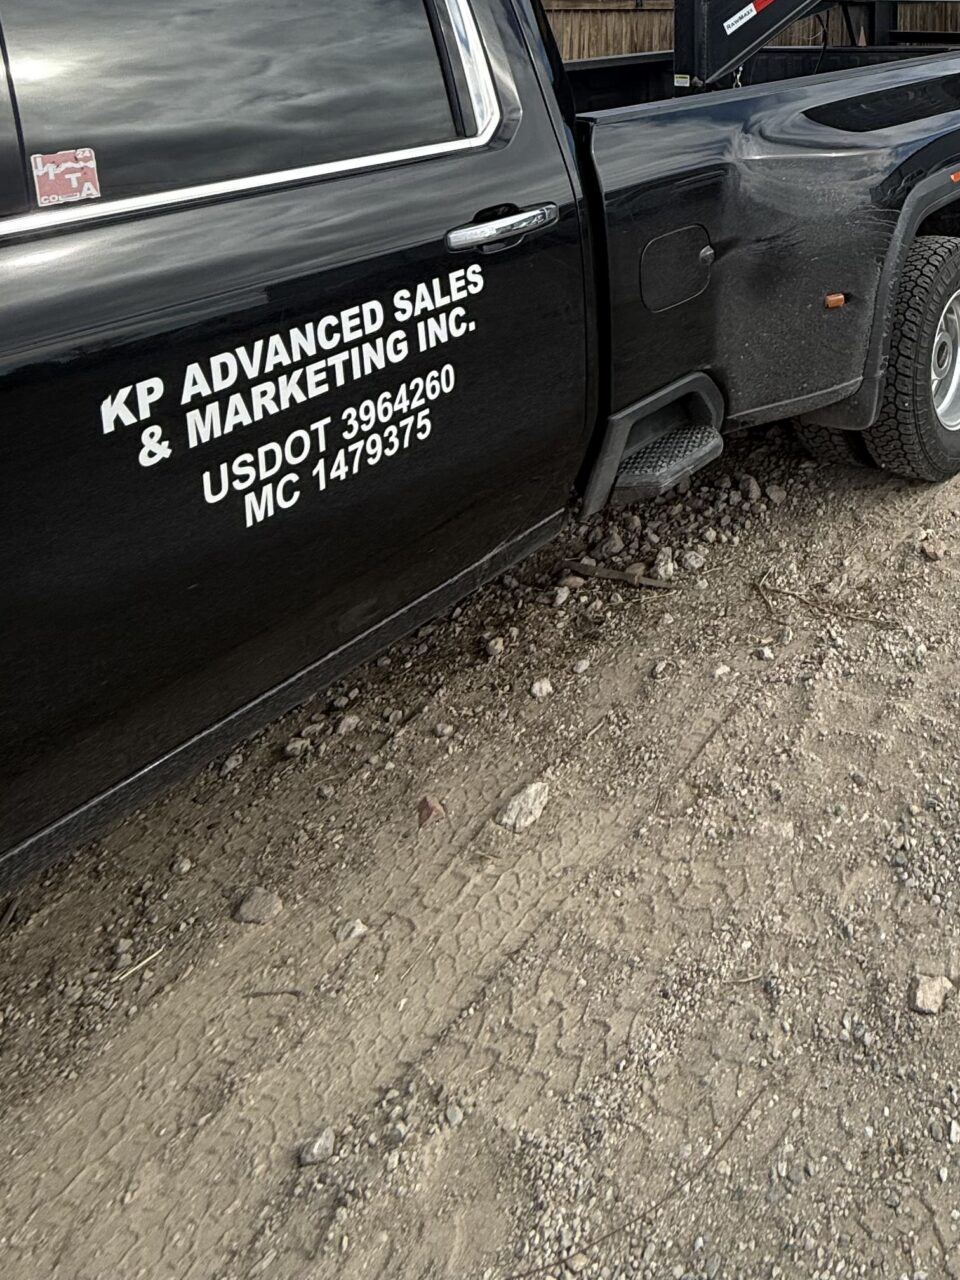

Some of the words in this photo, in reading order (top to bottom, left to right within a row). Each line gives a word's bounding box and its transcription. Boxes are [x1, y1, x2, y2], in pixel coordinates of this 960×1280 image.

[100, 377, 164, 435] KP
[180, 299, 384, 405] ADVANCED
[393, 264, 484, 322] SALES
[138, 425, 172, 467] &
[185, 329, 409, 449] MARKETING
[417, 306, 476, 352] INC.
[202, 416, 332, 504] USDOT
[341, 363, 455, 440] 3964260
[244, 472, 300, 528] MC
[312, 408, 432, 491] 1479375
